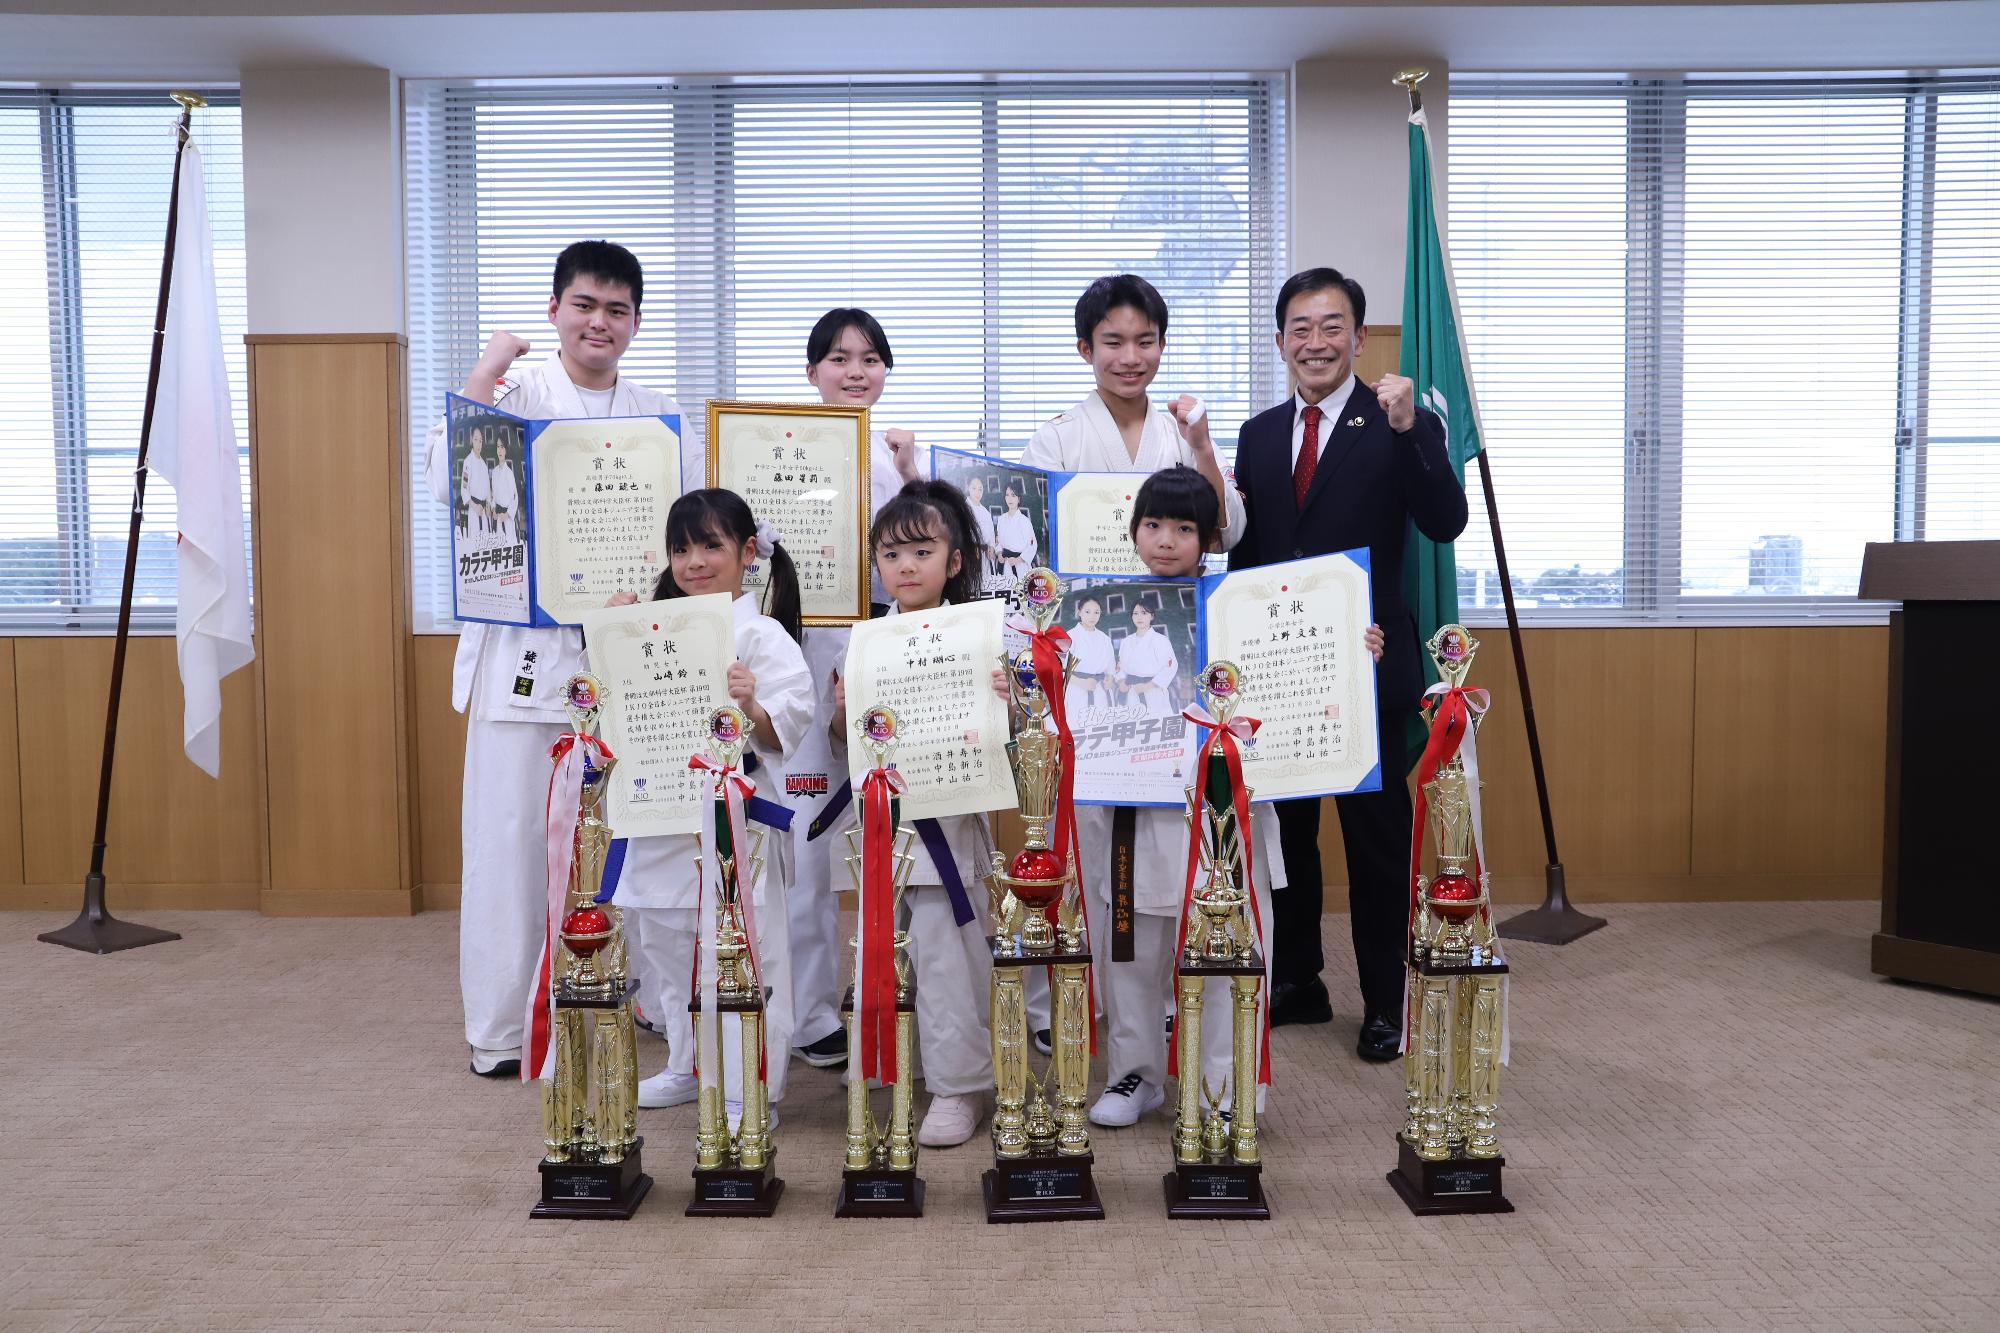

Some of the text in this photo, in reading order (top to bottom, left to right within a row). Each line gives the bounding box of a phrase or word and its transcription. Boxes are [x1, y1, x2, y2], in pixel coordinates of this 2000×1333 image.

[772, 446, 806, 460] 賞状
[593, 457, 627, 470] 賞状
[774, 472, 794, 482] 藤田
[752, 508, 832, 516] 手権大会に於いて頭書の
[460, 544, 524, 576] カラテ甲子園
[796, 572, 835, 580] 島新治
[1268, 600, 1304, 618] 賞状
[906, 634, 942, 647] 賞状
[1270, 630, 1290, 642] 上野
[642, 640, 677, 658] 賞状
[906, 657, 927, 668] 中村
[1249, 664, 1336, 681] 手権大会に於いて頭書の
[1072, 715, 1186, 751] ラテ甲子園
[786, 777, 828, 790] RANKING
